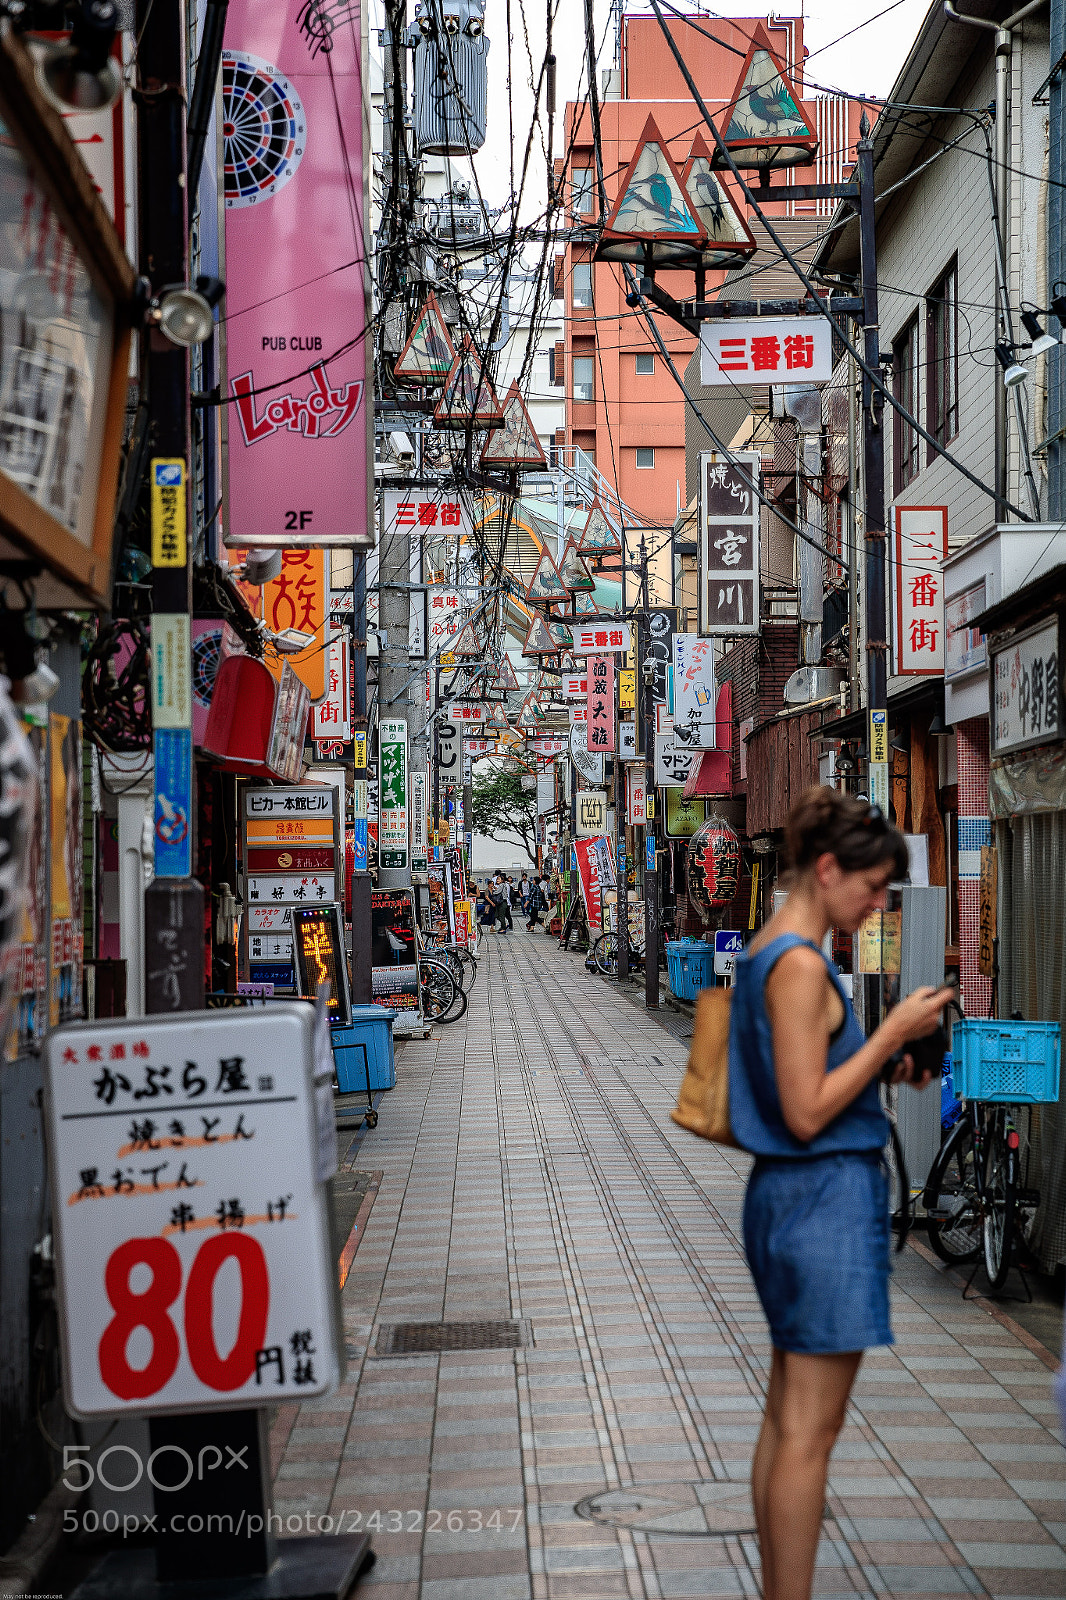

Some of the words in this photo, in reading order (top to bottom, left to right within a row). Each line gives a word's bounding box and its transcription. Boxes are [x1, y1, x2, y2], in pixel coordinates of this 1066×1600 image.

[262, 337, 286, 350] PUB
[290, 337, 322, 351] CLUB
[719, 334, 814, 371] 三番街
[230, 359, 364, 447] Landy
[709, 463, 750, 515] 焼とり
[284, 510, 313, 530] 2F
[395, 501, 461, 527] 三番街
[713, 530, 747, 625] 宮川
[907, 530, 939, 653] 三番街
[581, 631, 623, 647] 三番街
[381, 724, 405, 732] 不動産
[452, 708, 482, 719] 三番街
[534, 741, 562, 751] 三番街
[874, 723, 884, 760] 防犯カメラ作動中
[381, 744, 400, 804] マツザキ
[632, 773, 644, 817] 三番街
[252, 937, 262, 957] 地階
[725, 935, 743, 950] As
[61, 1040, 150, 1065] 大衆酒場
[93, 1056, 250, 1106] かぶら屋
[129, 1114, 254, 1150] 焼きとん
[78, 1161, 198, 1199] 黒おでん
[169, 1194, 292, 1233] 串揚げ
[99, 1232, 269, 1400] 80
[255, 1346, 285, 1385] 円
